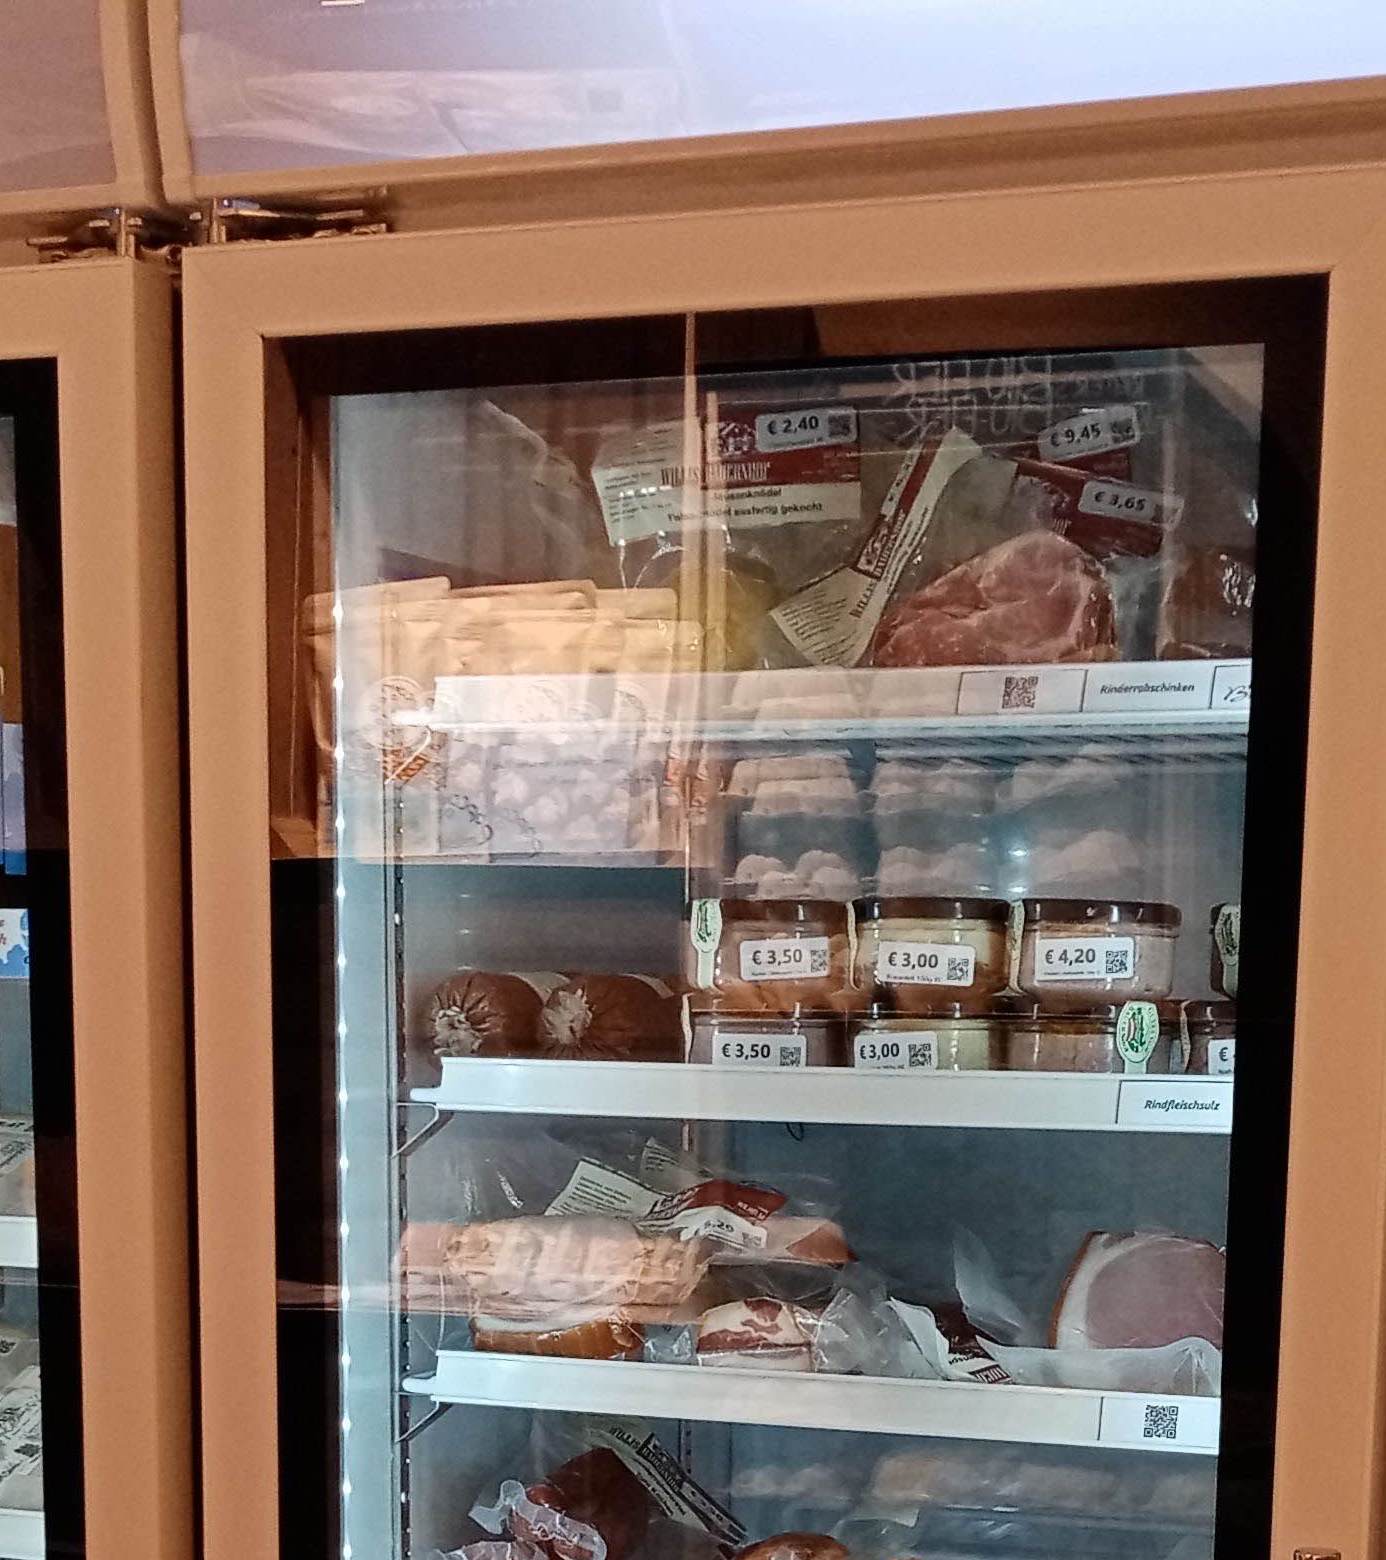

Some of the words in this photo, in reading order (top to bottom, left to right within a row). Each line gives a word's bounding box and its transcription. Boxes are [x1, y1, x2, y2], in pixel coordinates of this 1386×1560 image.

[782, 416, 820, 433] 2,40
[1065, 425, 1102, 443] 9,45
[767, 949, 803, 966] 3,50
[900, 952, 939, 969] 3,00
[1058, 948, 1097, 967] 4,20
[734, 1043, 771, 1060] 3,50
[868, 1042, 900, 1060] 3,00
[1144, 1098, 1221, 1112] Rindfleischsulz
